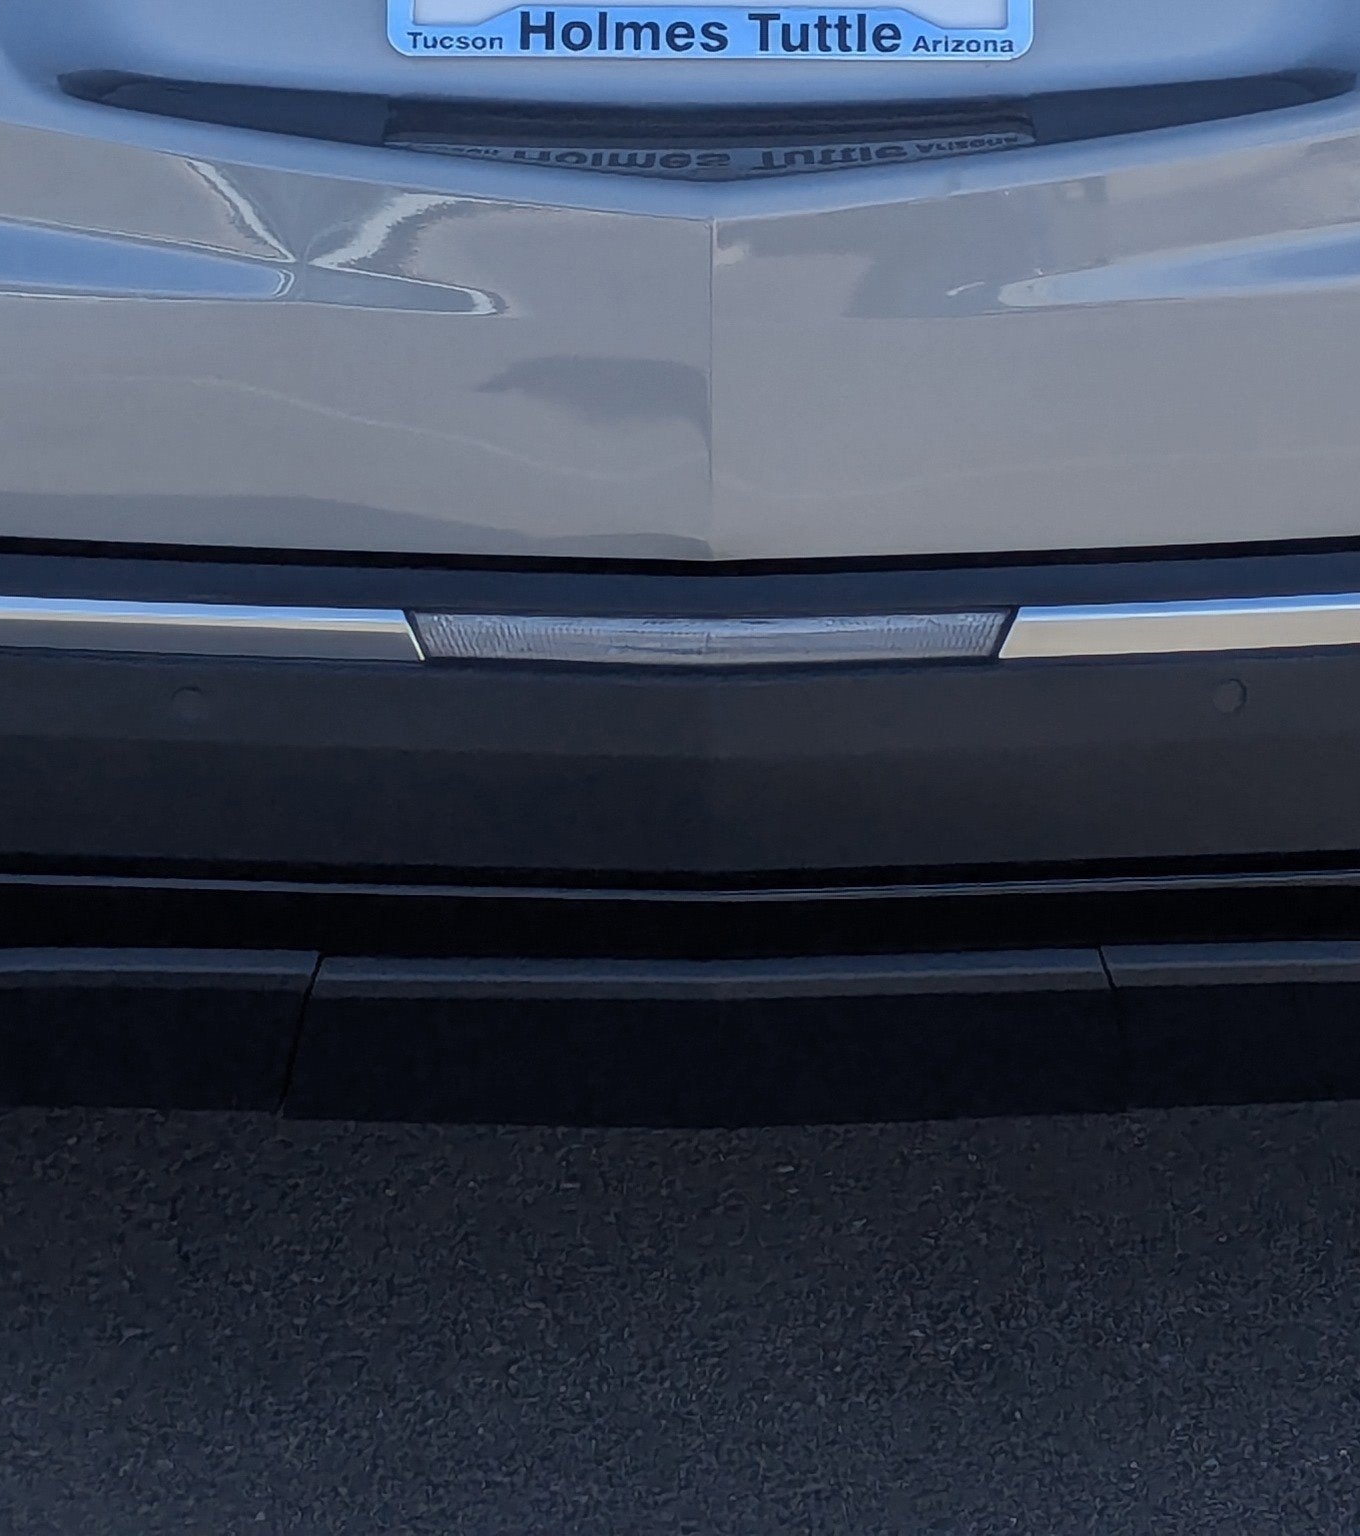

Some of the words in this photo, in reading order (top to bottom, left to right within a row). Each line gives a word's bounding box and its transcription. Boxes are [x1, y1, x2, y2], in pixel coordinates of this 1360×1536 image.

[407, 31, 503, 50] Tucson
[519, 10, 729, 53] Holmes
[748, 13, 902, 53] Tuttle
[912, 35, 1014, 53] Arizona
